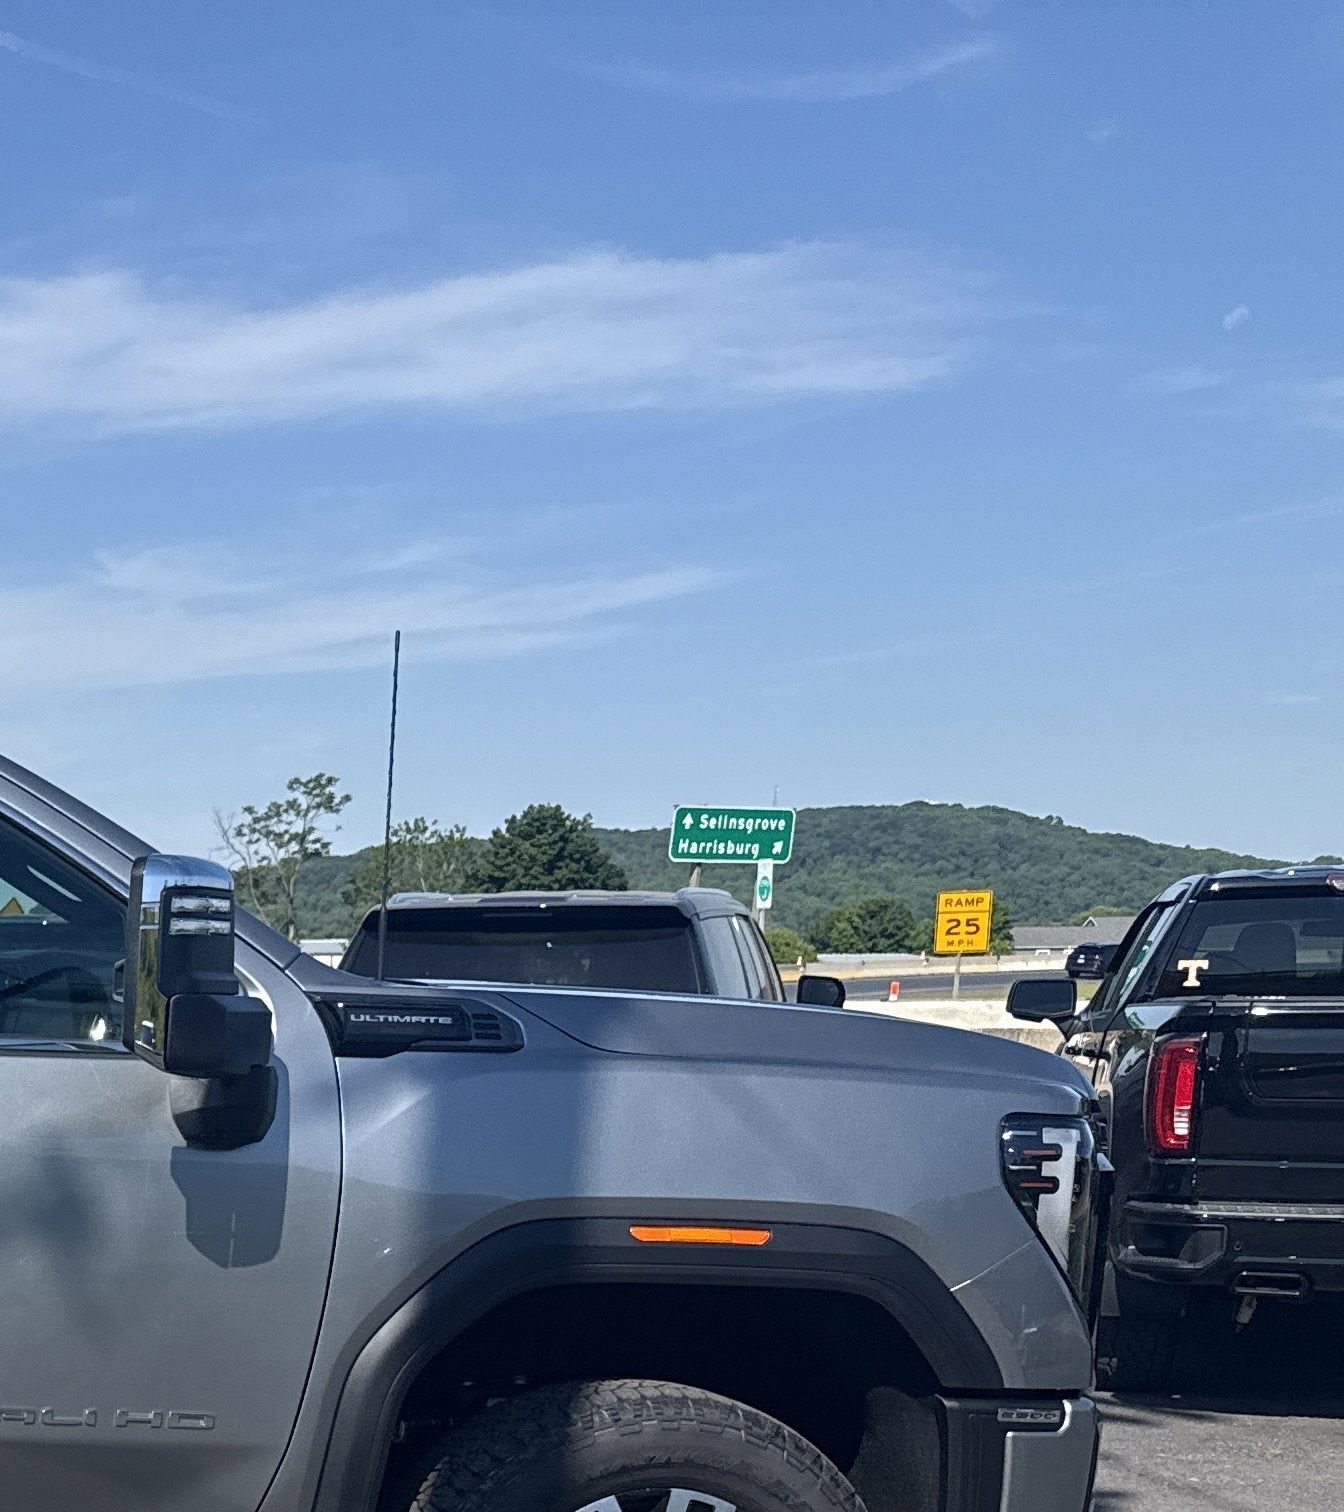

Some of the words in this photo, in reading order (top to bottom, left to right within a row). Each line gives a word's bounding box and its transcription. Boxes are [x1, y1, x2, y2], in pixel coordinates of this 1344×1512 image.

[698, 813, 786, 835] Selinsgrove
[677, 838, 760, 860] Harrisburg
[944, 896, 985, 908] RAMP
[944, 917, 980, 936] 25
[350, 1013, 453, 1025] ULTIMATE
[115, 1408, 216, 1430] HD
